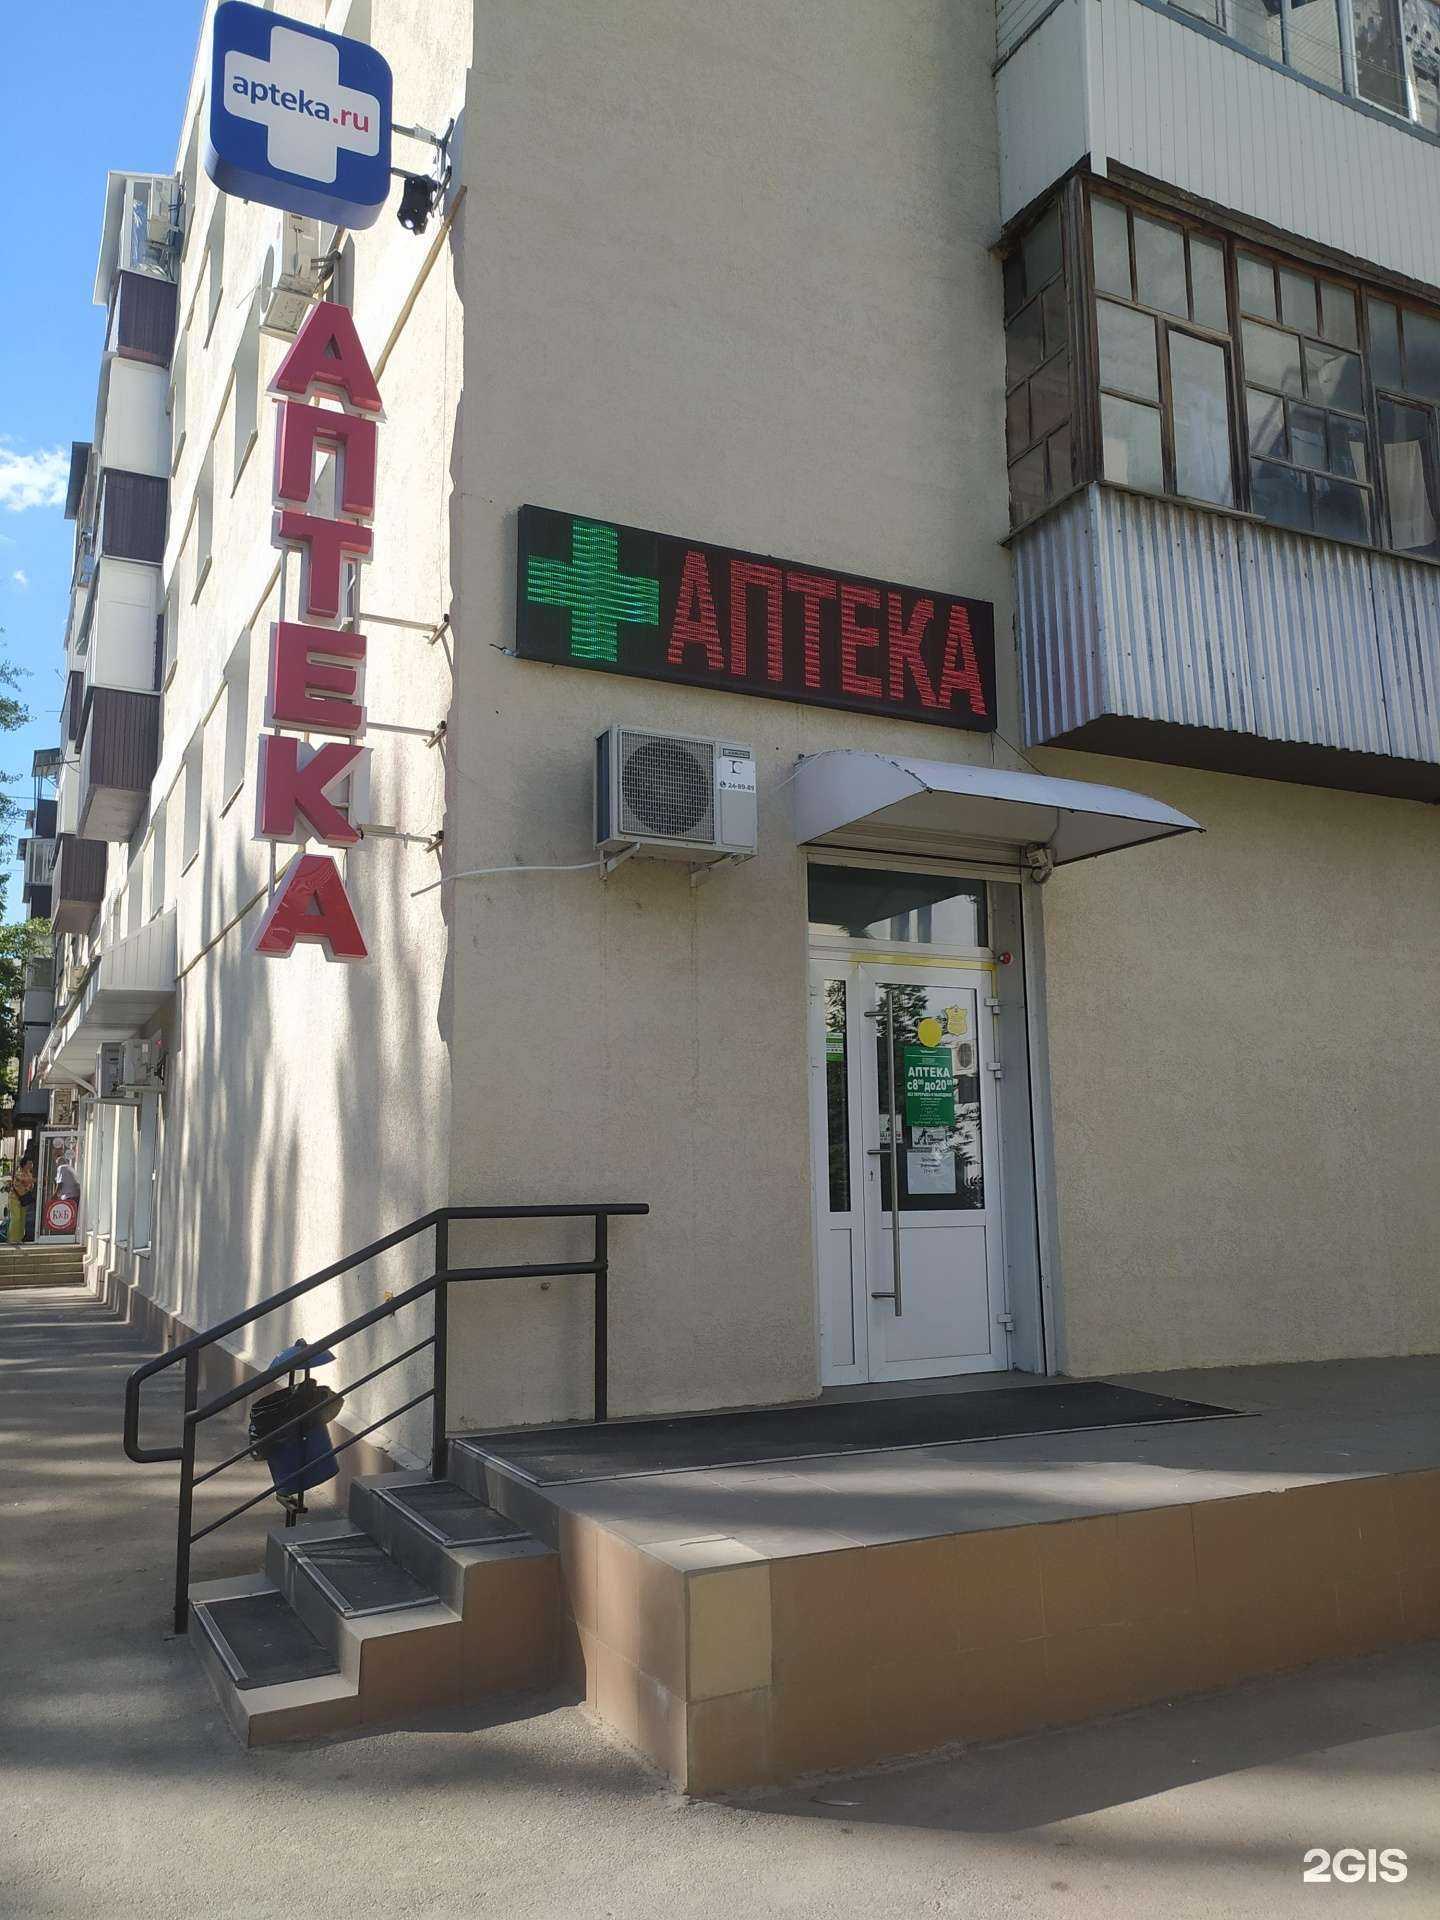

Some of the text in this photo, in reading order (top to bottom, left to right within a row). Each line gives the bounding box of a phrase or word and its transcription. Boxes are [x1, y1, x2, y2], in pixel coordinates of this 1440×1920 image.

[232, 75, 369, 133] apteka.ru
[254, 300, 384, 960] АПТЕКА
[667, 550, 988, 716] АПТЕКА
[907, 1066, 951, 1078] АПТЕКА
